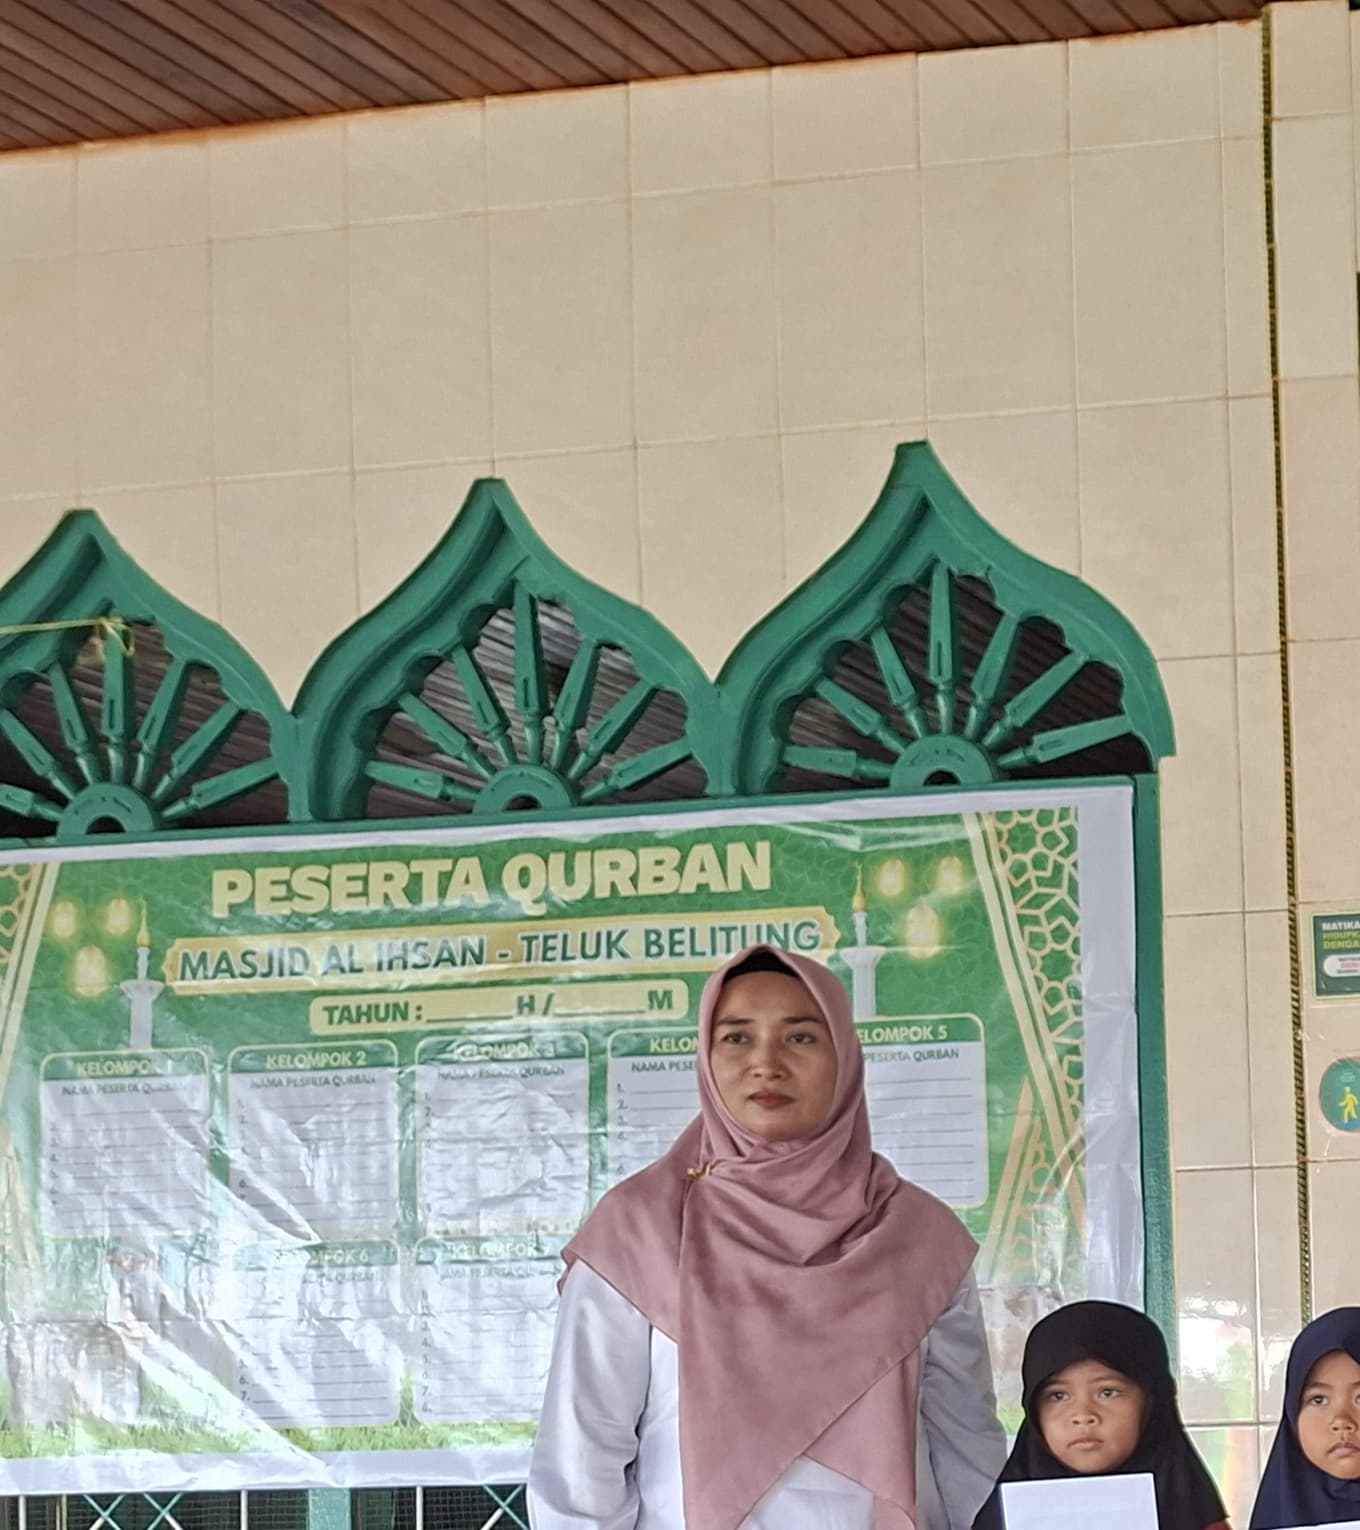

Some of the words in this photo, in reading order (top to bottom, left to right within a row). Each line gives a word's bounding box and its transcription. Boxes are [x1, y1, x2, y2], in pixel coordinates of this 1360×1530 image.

[212, 857, 490, 918] PESERTA
[502, 841, 771, 916] QURBAN
[179, 947, 311, 982] MASJID
[321, 944, 363, 974] AL
[376, 937, 486, 972] IHSAN
[520, 929, 632, 964] TELUK
[644, 921, 820, 958] BELITUNG
[322, 1002, 409, 1026] TAHUN
[857, 1025, 934, 1044] ELOMPOK
[938, 1025, 948, 1040] 5
[266, 1051, 352, 1070] KELOMPOK
[356, 1051, 367, 1067] 2
[913, 1047, 960, 1062] QURBAN
[631, 1061, 666, 1073] NAMA
[668, 1060, 698, 1072] PESE
